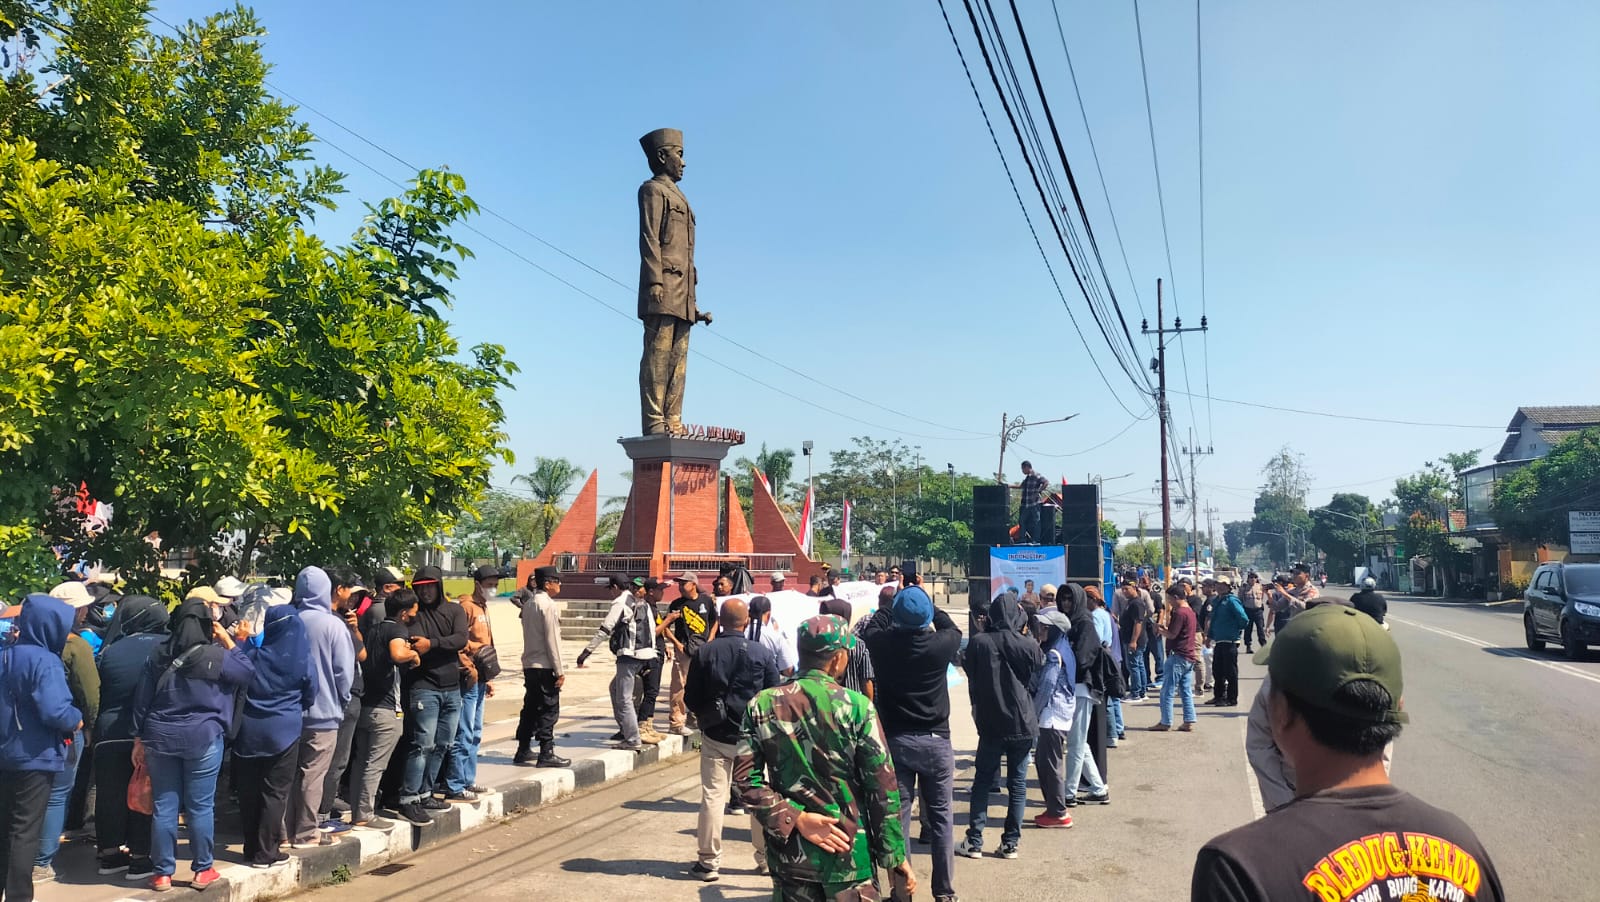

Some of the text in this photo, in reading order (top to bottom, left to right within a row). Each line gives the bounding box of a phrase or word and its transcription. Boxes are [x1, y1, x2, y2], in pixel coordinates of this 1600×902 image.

[1304, 833, 1480, 902] BLEDUG KELUD
[1387, 876, 1418, 899] BUNG
